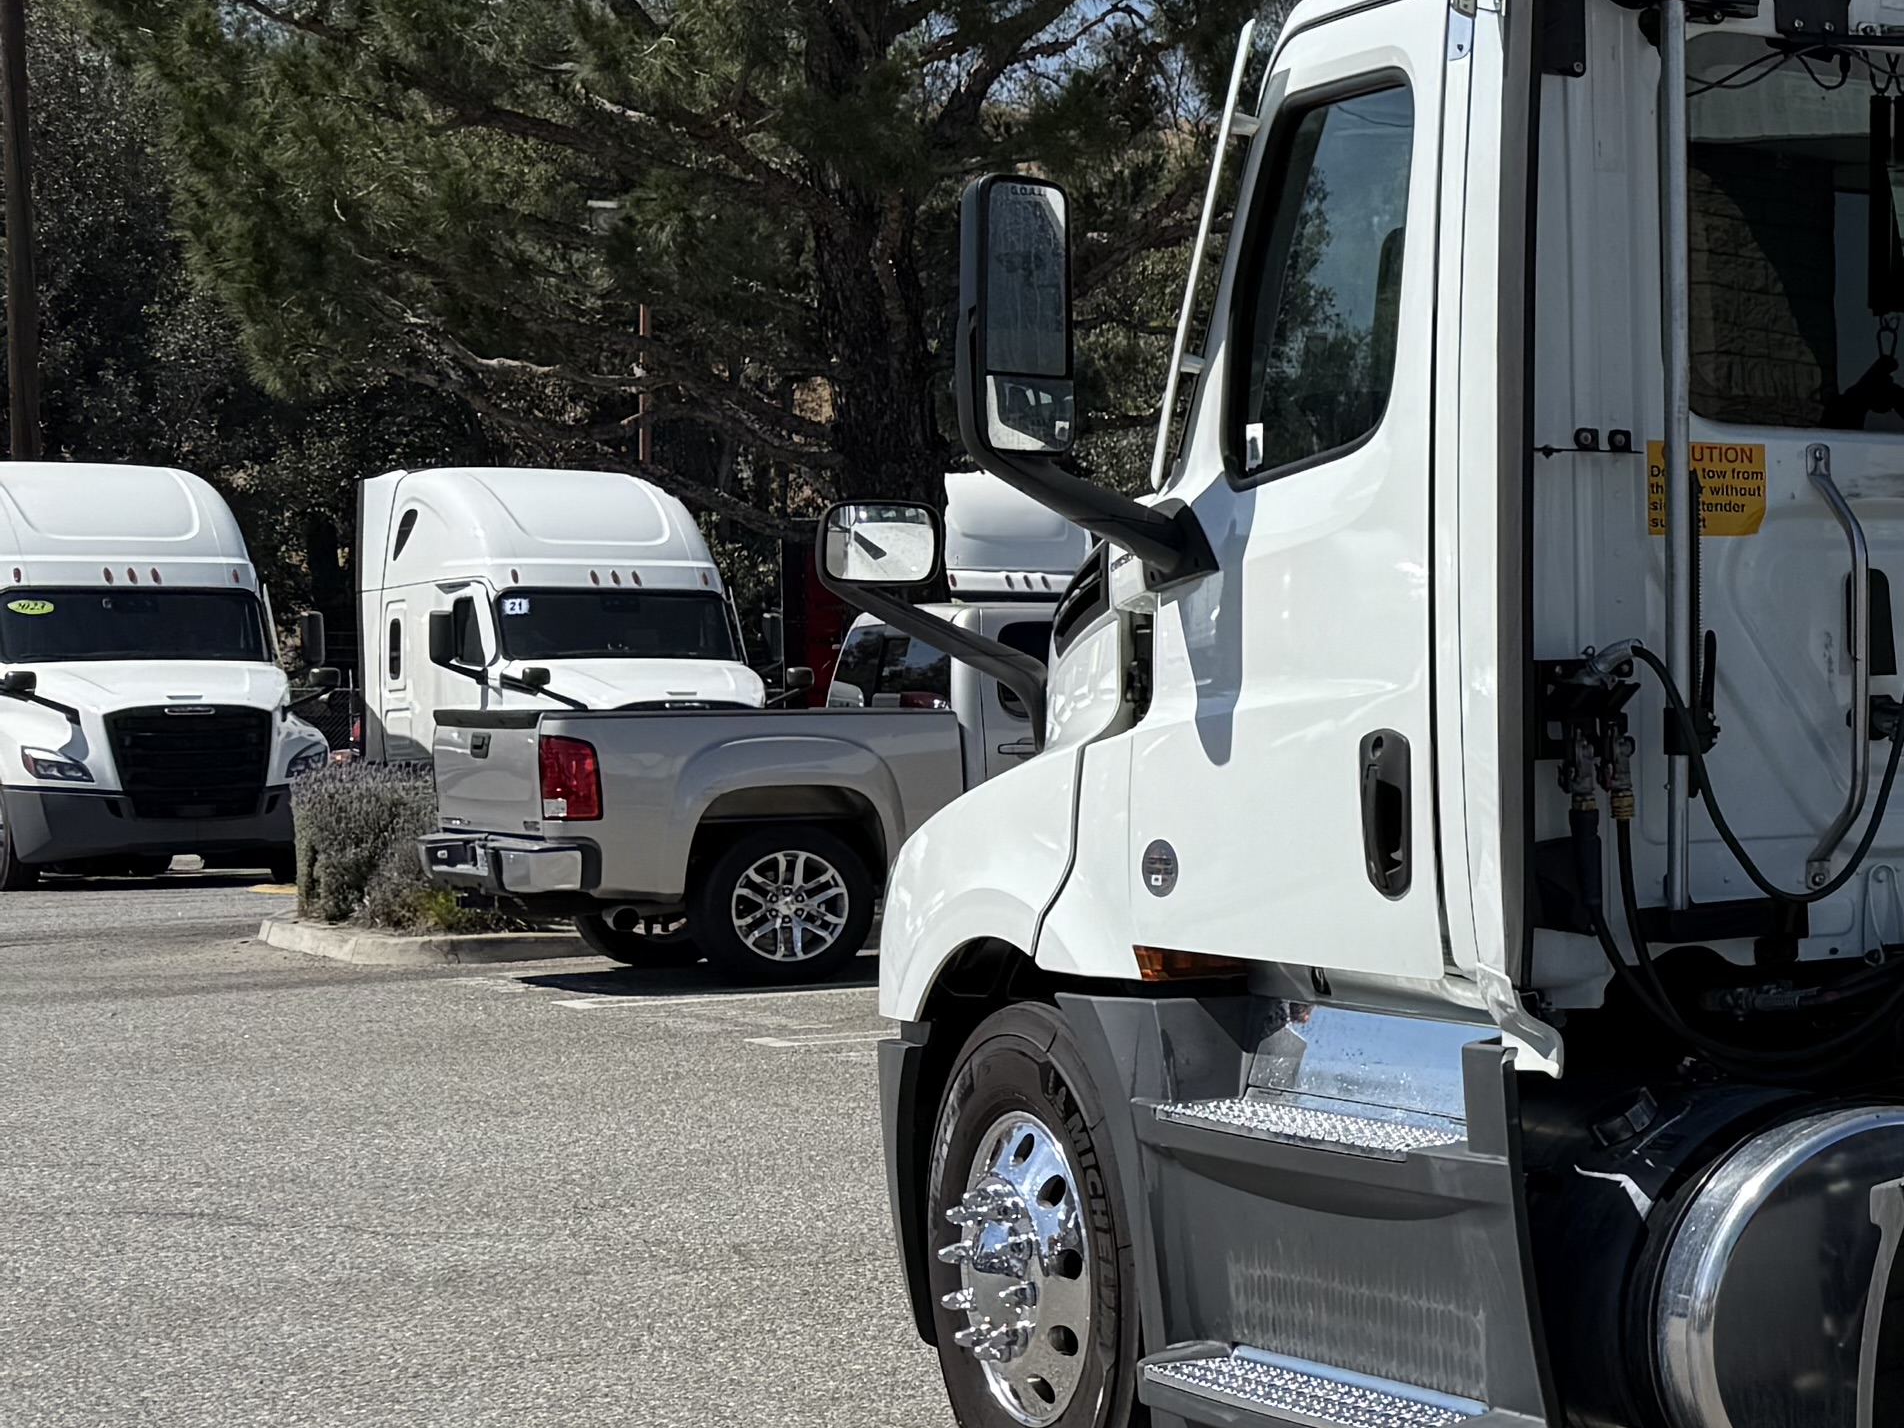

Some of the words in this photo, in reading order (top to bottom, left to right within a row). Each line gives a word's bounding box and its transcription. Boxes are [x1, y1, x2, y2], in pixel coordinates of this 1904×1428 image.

[1702, 467, 1727, 480] tow
[1732, 468, 1764, 481] from
[1709, 485, 1762, 497] without
[1701, 500, 1746, 513] tender
[1067, 1111, 1117, 1351] MICHELIN
